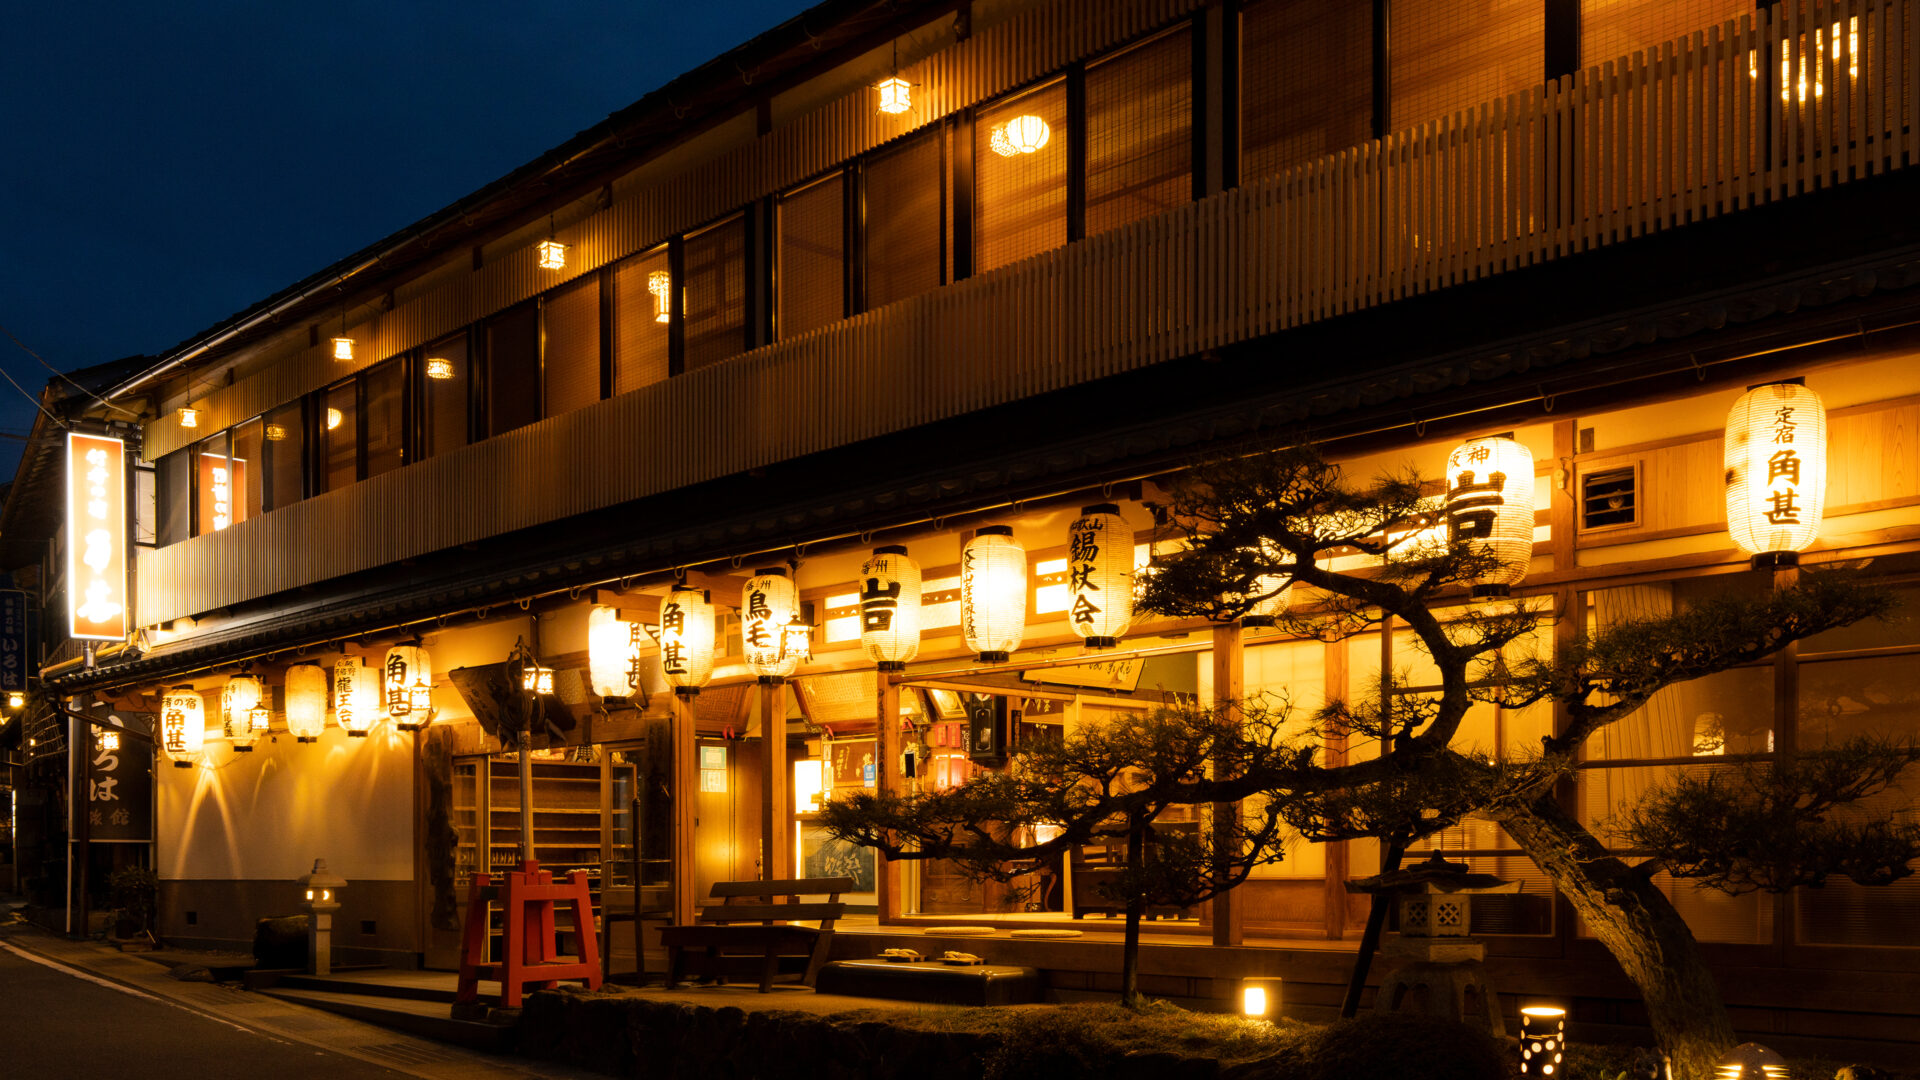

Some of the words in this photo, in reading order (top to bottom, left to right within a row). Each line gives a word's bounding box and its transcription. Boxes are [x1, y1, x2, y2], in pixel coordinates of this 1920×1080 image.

[1774, 405, 1798, 445] 定宿
[1761, 449, 1802, 526] 角甚
[1069, 533, 1102, 624] 錫杖会
[661, 601, 689, 676] 角甚
[745, 589, 773, 648] 鳥毛
[162, 696, 198, 710] 者の宿
[386, 652, 411, 717] 角甚
[164, 707, 187, 753] 角甚
